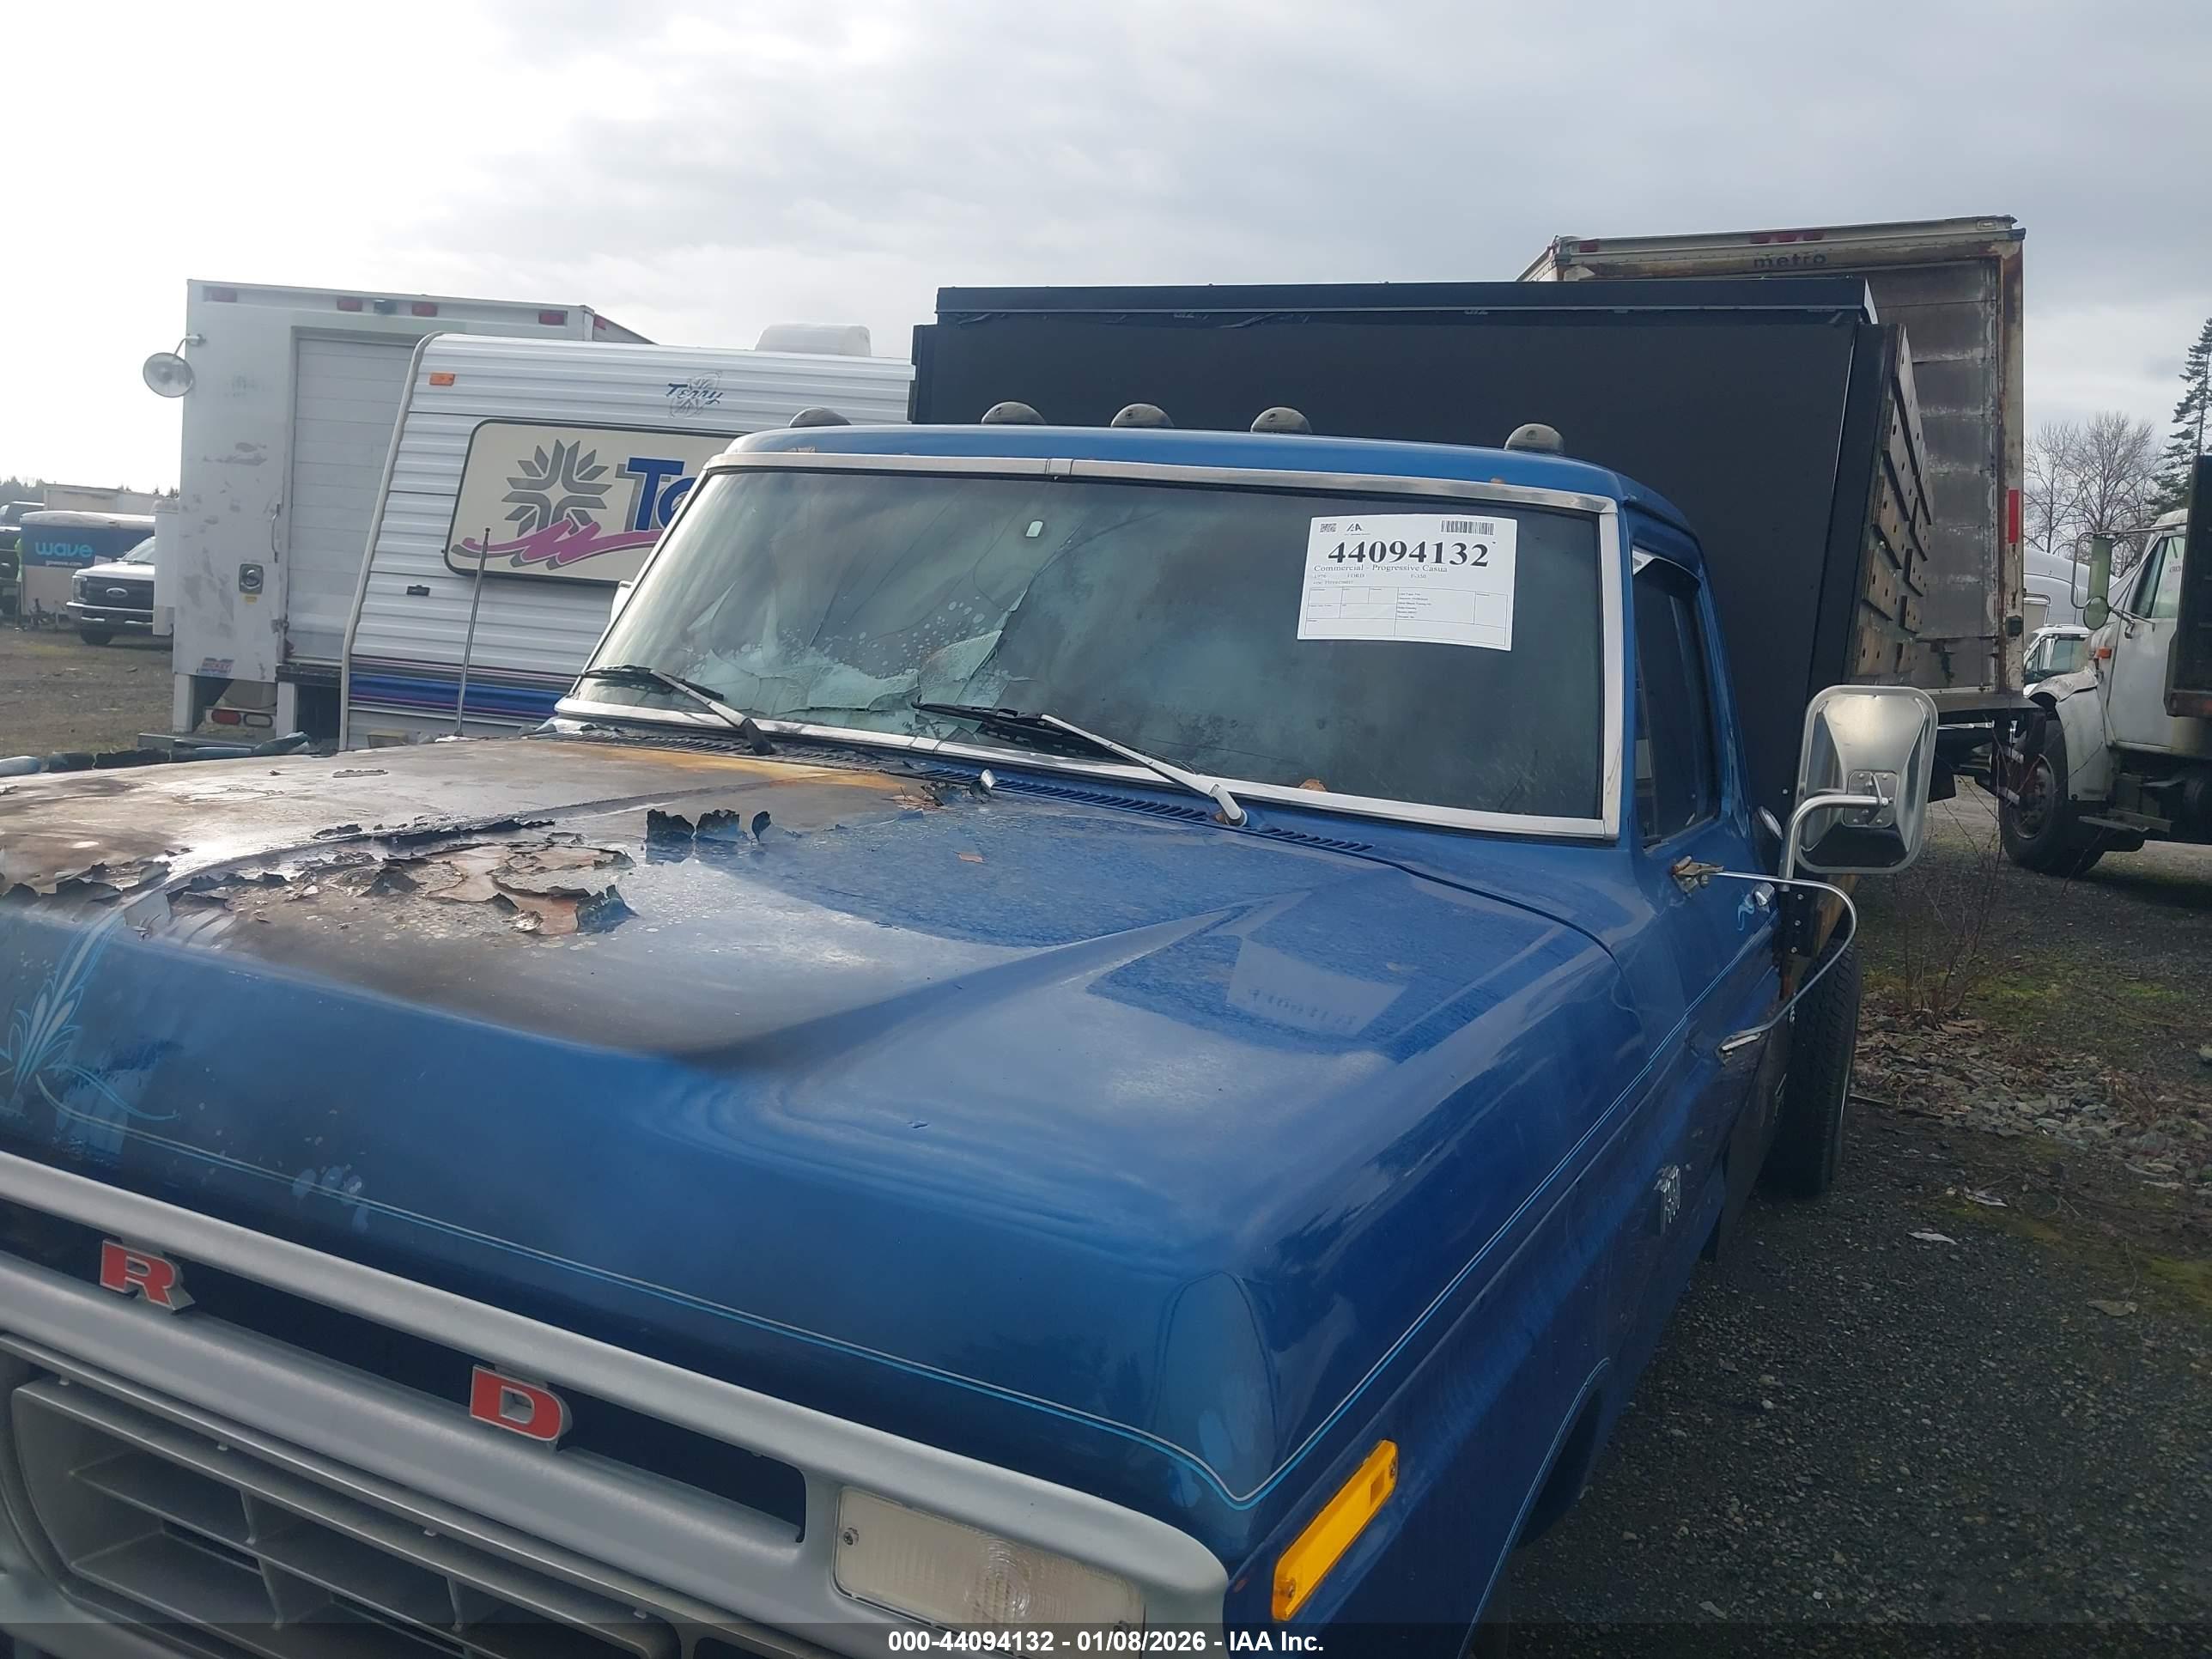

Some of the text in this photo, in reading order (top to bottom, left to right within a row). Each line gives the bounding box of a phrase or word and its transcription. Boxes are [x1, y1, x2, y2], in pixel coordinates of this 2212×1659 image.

[1753, 254, 1827, 268] metro
[665, 383, 724, 405] Terry
[34, 541, 94, 558] wave
[1328, 541, 1489, 568] 44094132
[1372, 564, 1419, 573] Progressive
